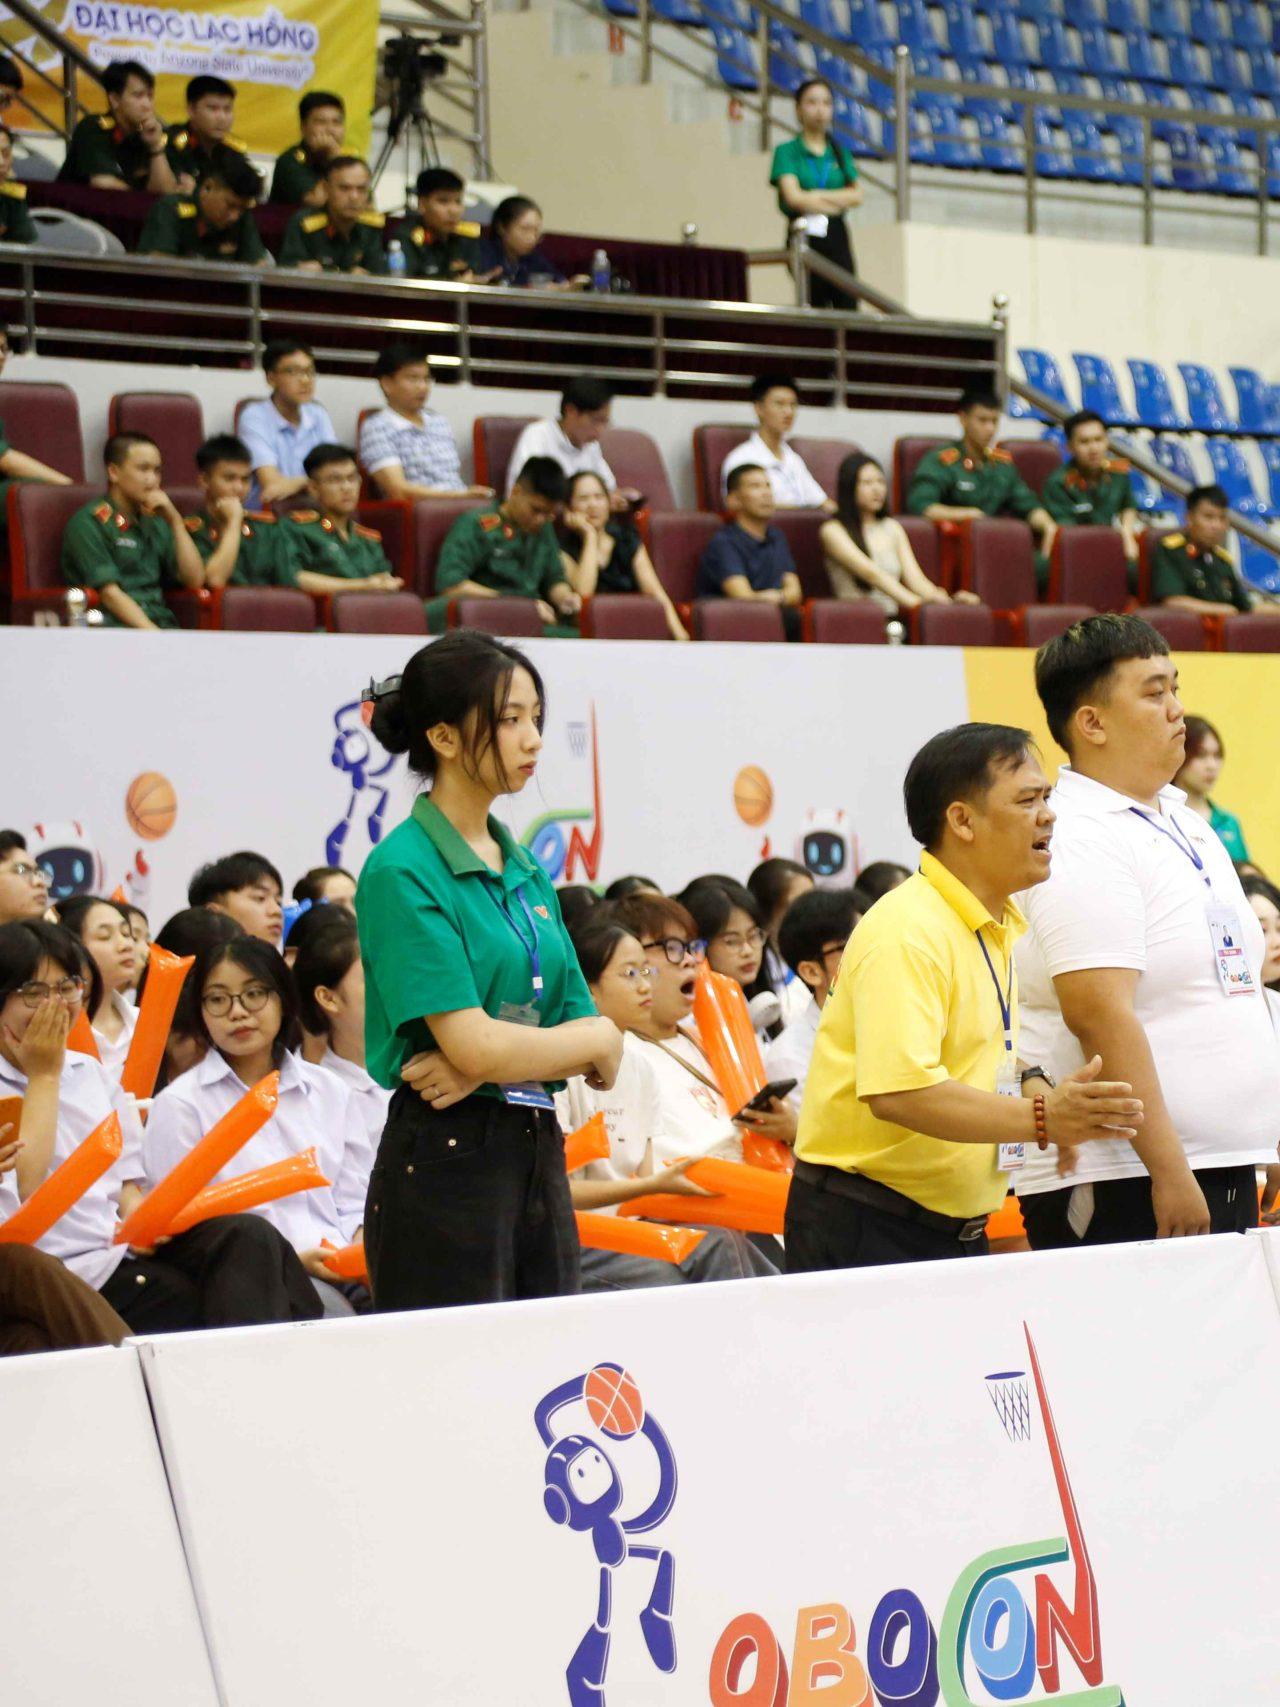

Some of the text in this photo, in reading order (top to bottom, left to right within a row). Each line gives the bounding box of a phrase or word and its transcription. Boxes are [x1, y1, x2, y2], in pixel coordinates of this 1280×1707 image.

[75, 5, 119, 36] ĐẠI
[127, 12, 185, 40] HỌC
[192, 18, 241, 47] LẠC
